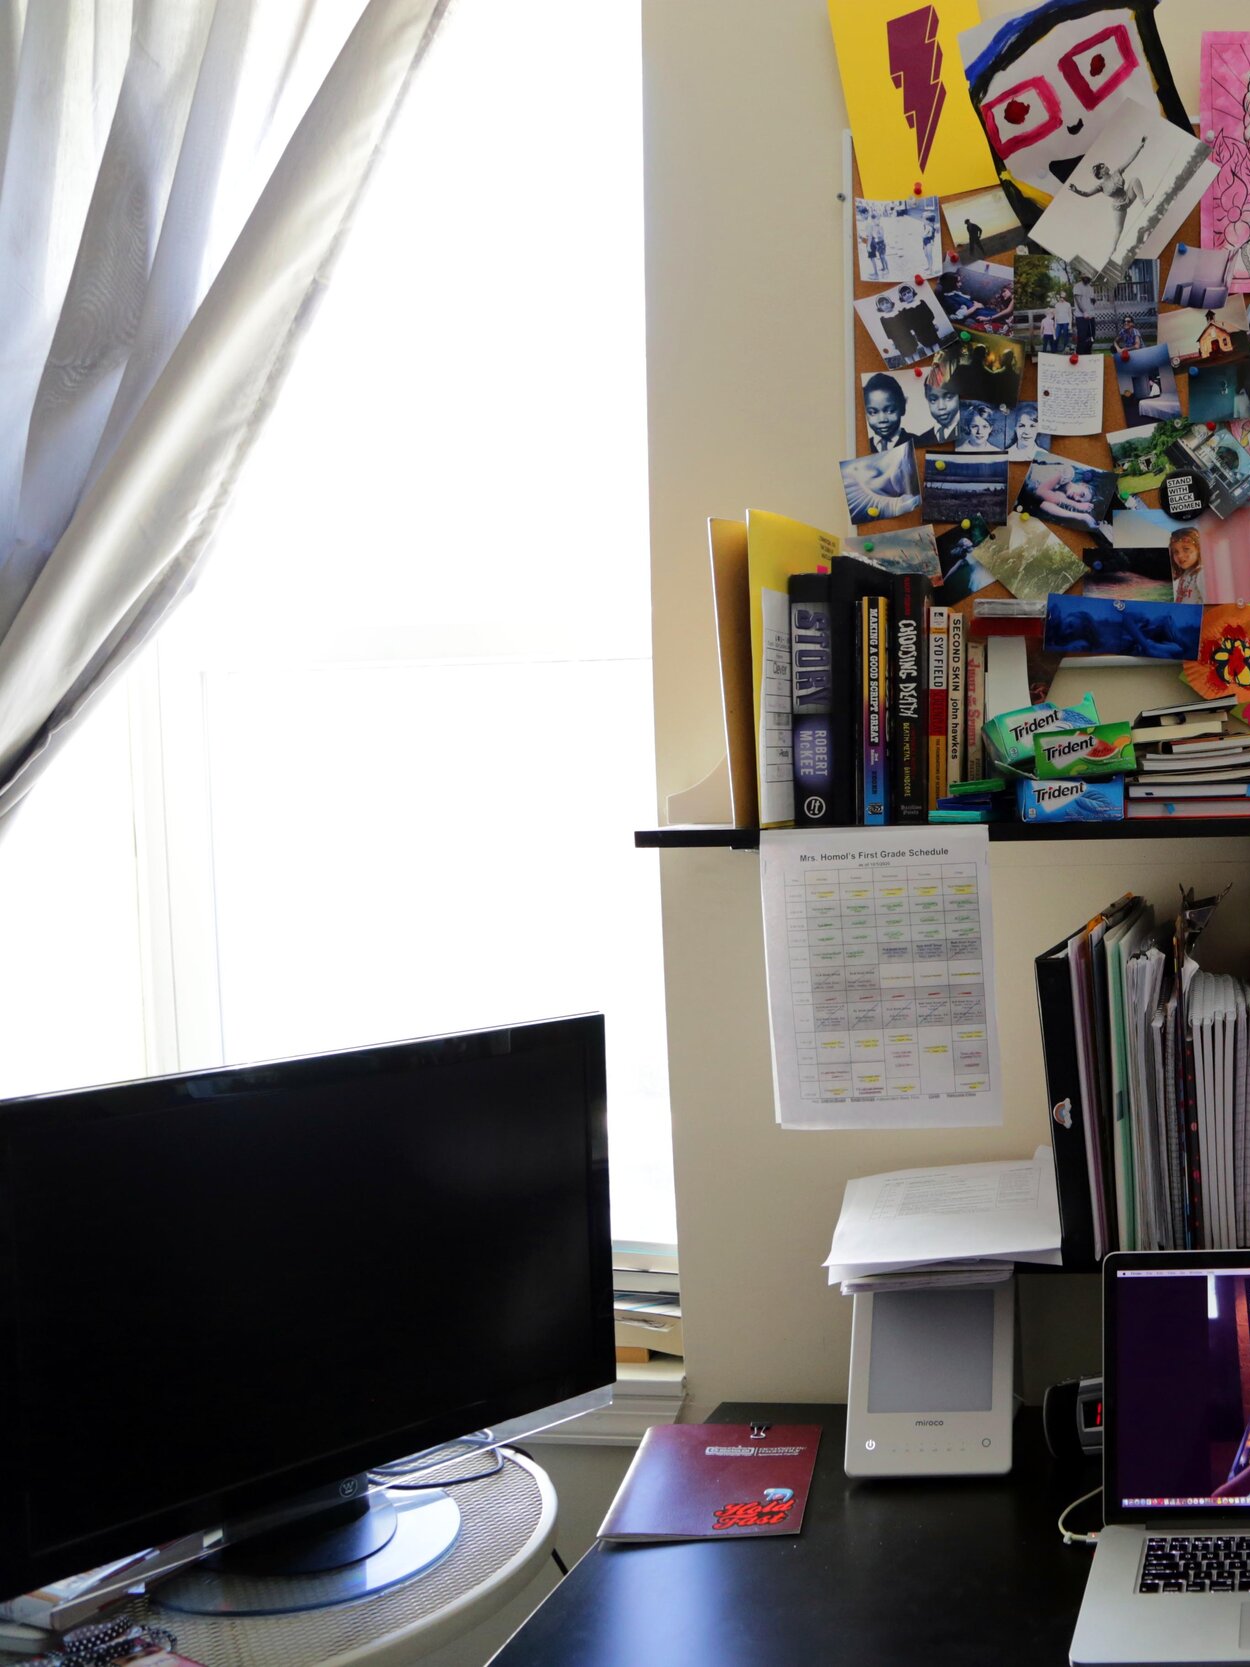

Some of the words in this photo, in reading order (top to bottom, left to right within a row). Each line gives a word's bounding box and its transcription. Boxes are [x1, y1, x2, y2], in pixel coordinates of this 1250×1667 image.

[1167, 477, 1192, 487] STAND
[1168, 486, 1188, 495] WITH
[1169, 494, 1193, 504] BLACK
[1170, 501, 1201, 511] WOMEN
[869, 608, 879, 646] MAKING
[869, 646, 879, 655] A
[898, 619, 917, 679] CHOOSING
[934, 636, 944, 656] SYD
[952, 618, 961, 663] SECOND
[794, 608, 831, 706] STORY
[869, 655, 879, 679] GOOD
[934, 656, 944, 688] FIELD
[952, 666, 961, 692] SKIN
[869, 680, 879, 713] SCRIPT
[899, 682, 918, 718] DEATH
[950, 697, 960, 720] john
[869, 713, 879, 743] GREAT
[903, 722, 911, 741] DEATH
[1009, 709, 1060, 742] Trident
[903, 742, 911, 761] METAL
[951, 722, 961, 759] hawkes
[1042, 735, 1095, 762] Trident
[800, 730, 814, 776] McKEE
[815, 730, 828, 776] ROBERT
[1033, 781, 1085, 804] Trident
[799, 854, 818, 862] Mrs.
[820, 852, 856, 861] Homol's
[858, 851, 878, 859] First
[880, 850, 906, 858] Grade
[908, 847, 949, 857] Schedule
[914, 1419, 944, 1427] miroco
[714, 1499, 796, 1518] Hold
[712, 1512, 786, 1530] Fast
